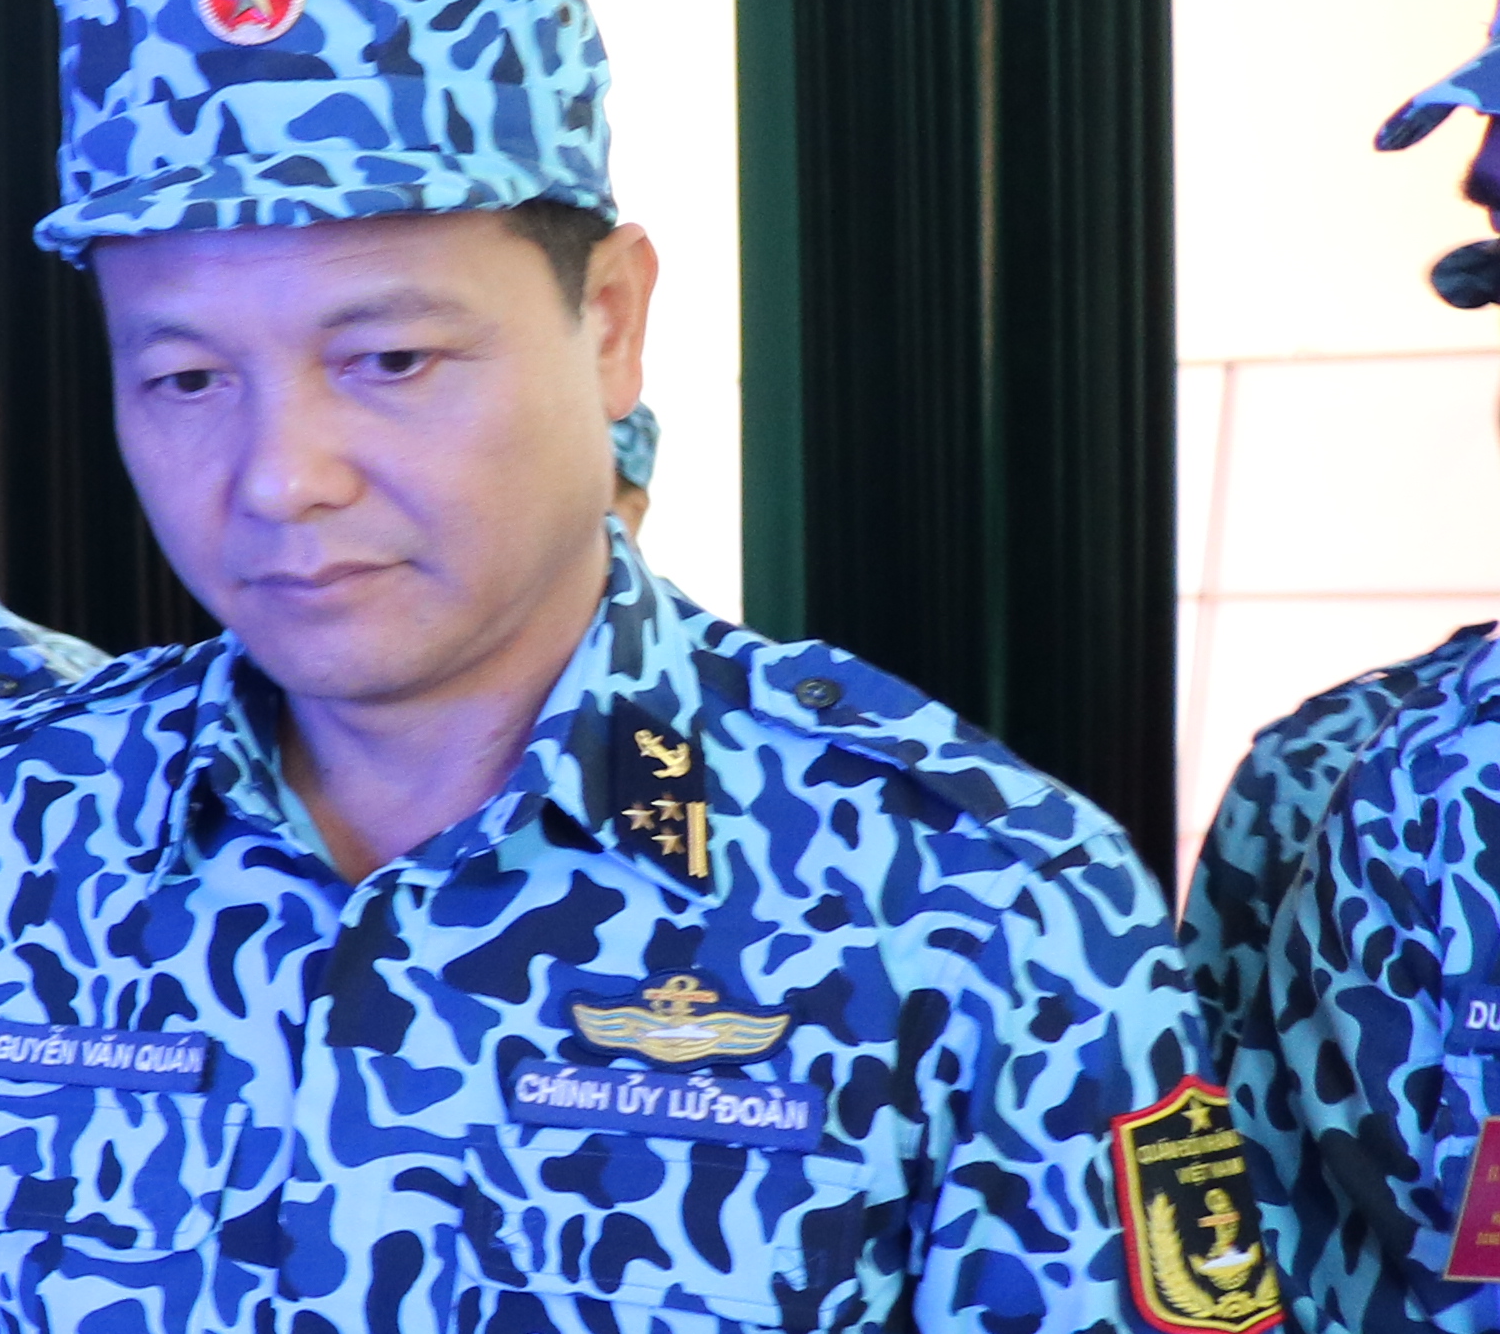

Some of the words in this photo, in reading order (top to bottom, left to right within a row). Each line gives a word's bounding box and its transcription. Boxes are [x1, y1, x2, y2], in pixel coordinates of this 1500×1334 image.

[81, 1033, 136, 1070] VĂN
[514, 1067, 612, 1111] CHÍNH
[711, 1085, 810, 1130] ĐOÀN
